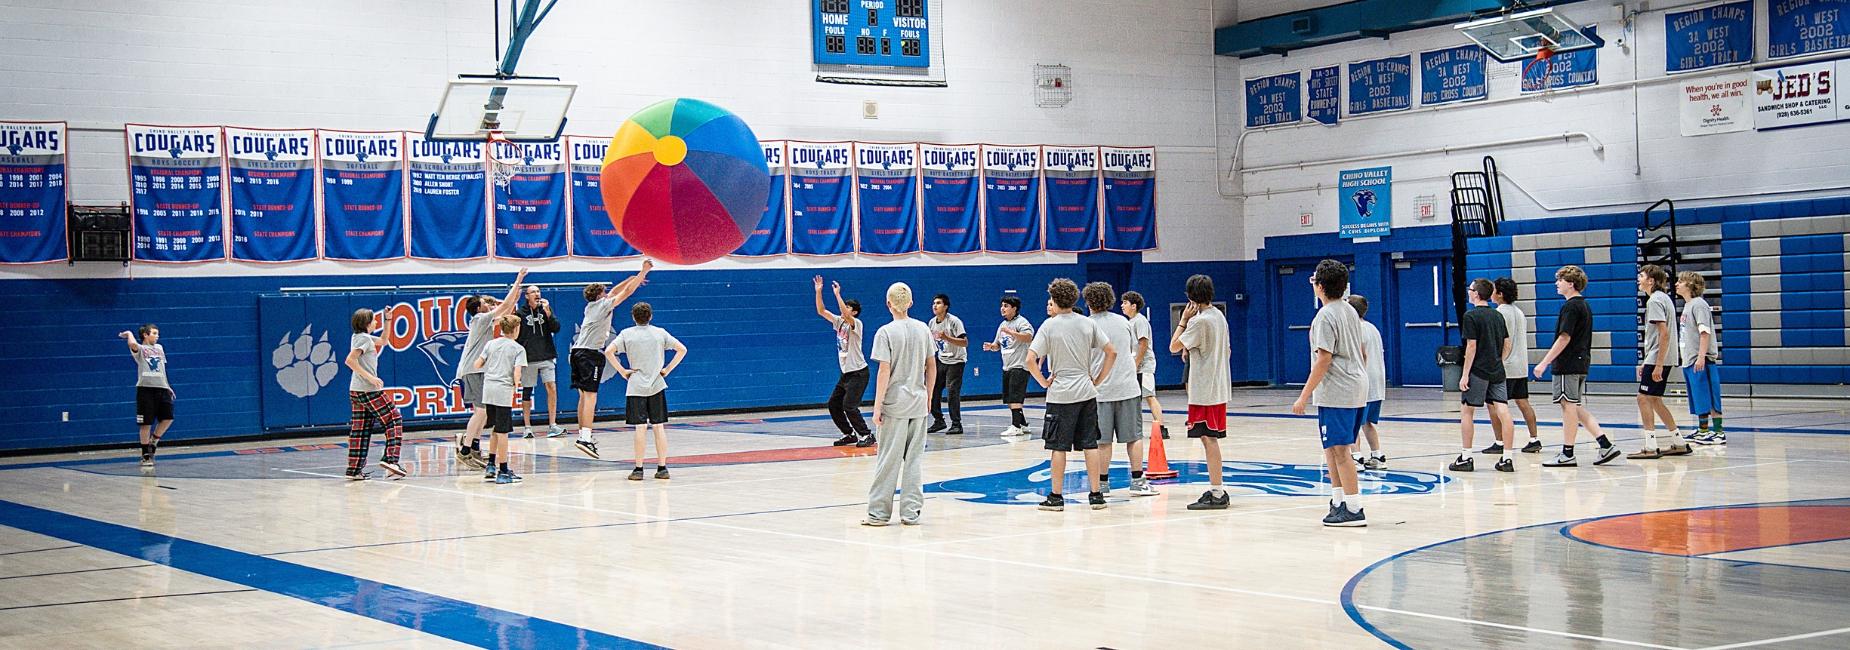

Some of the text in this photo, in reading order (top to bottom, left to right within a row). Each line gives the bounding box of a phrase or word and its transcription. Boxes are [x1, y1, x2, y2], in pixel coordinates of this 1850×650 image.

[861, 1, 884, 9] PERIOD
[822, 13, 927, 29] HOME VISITOR
[1673, 6, 1746, 32] REGION CHAMPS
[1794, 9, 1839, 27] 3A WEST
[825, 26, 845, 34] FOULS
[861, 28, 870, 36] NO
[900, 30, 920, 38] FOULS
[1688, 25, 1729, 43] 3A WEST
[1800, 23, 1833, 40] 2002
[1694, 39, 1725, 55] 2002
[1770, 42, 1796, 57] GIRLS
[1425, 49, 1481, 71] REGION CHAMPS
[1680, 49, 1738, 69] GIRLS TRACK
[1315, 68, 1334, 77] 1A-3A
[1350, 62, 1409, 83] REGION CO-CHAMPS
[1438, 62, 1470, 77] 3A WEST
[1568, 69, 1595, 84] COUNTRY
[1249, 76, 1296, 96] REGION CHAMPS
[1364, 72, 1395, 86] 3A WEST
[1442, 75, 1466, 88] 2002
[1685, 79, 1748, 94] When you're in good
[1773, 70, 1831, 101] JED'S
[1259, 91, 1286, 104] 3A WEST
[1315, 87, 1333, 99] STATE
[1369, 85, 1391, 97] 2003
[1423, 91, 1438, 102] BOYS
[1441, 88, 1459, 100] CROSS
[1689, 92, 1711, 102] health,
[1721, 90, 1729, 98] all
[1263, 102, 1284, 115] 2003
[1350, 100, 1367, 112] GIRLS
[1758, 103, 1784, 112] SANDWICH
[1805, 97, 1831, 106] CATERING
[1254, 111, 1292, 125] GIRLS TRACK
[135, 133, 215, 154] COUGARS
[233, 135, 309, 156] COUGARS
[326, 137, 397, 158] COUGARS
[413, 139, 481, 160] COUGARS
[495, 140, 561, 161] COUGARS
[575, 143, 609, 161] COUG
[792, 147, 848, 165] COUGARS
[859, 148, 913, 166] COUGARS
[924, 149, 975, 167] COUGARS
[987, 150, 1036, 168] COUGARS
[1046, 151, 1094, 168] COUGARS
[1105, 151, 1151, 169] COUGARS
[1342, 169, 1388, 180] CHINO VALLEY
[1342, 178, 1387, 188] HIGH SCHOOL
[1421, 204, 1432, 217] EXIT
[1300, 214, 1310, 224] EXIT
[381, 383, 536, 417] PRIE
